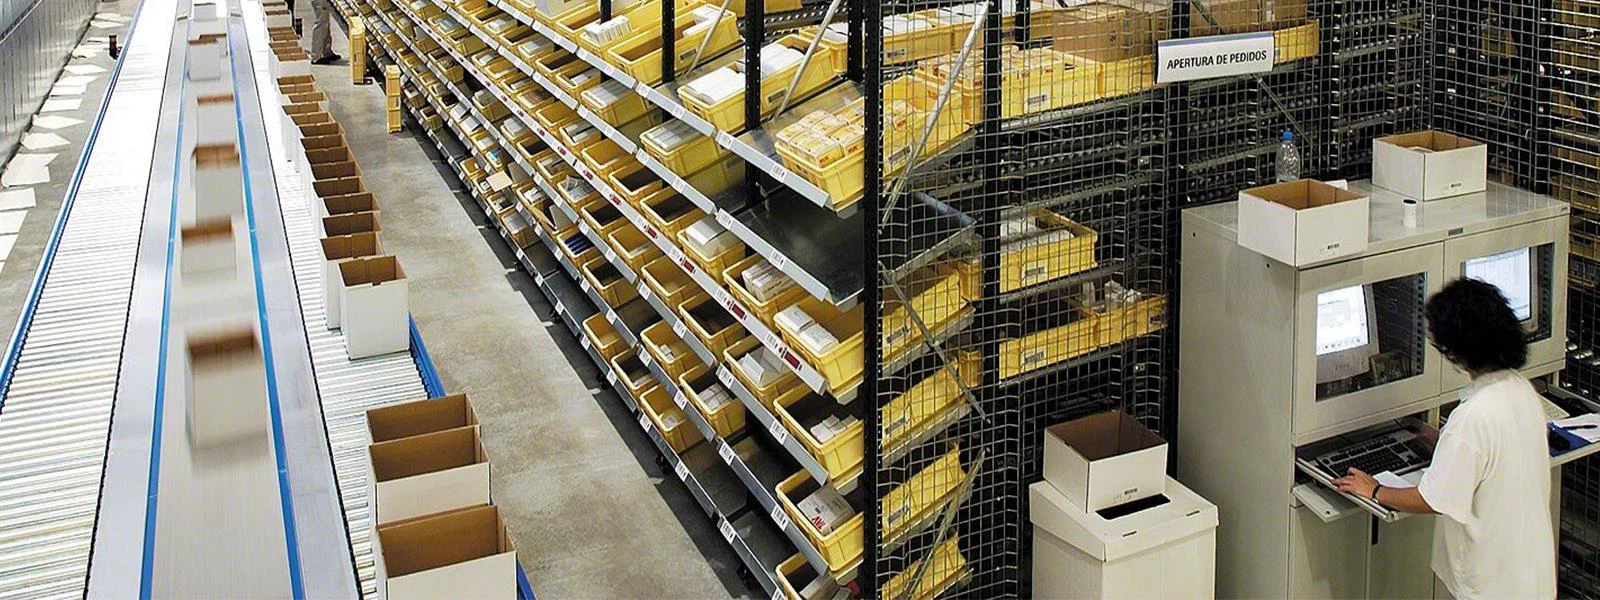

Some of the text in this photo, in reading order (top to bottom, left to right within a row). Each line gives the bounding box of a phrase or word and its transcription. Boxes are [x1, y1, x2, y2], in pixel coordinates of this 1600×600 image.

[1167, 50, 1267, 70] APERTURA DE PEDIDOS
